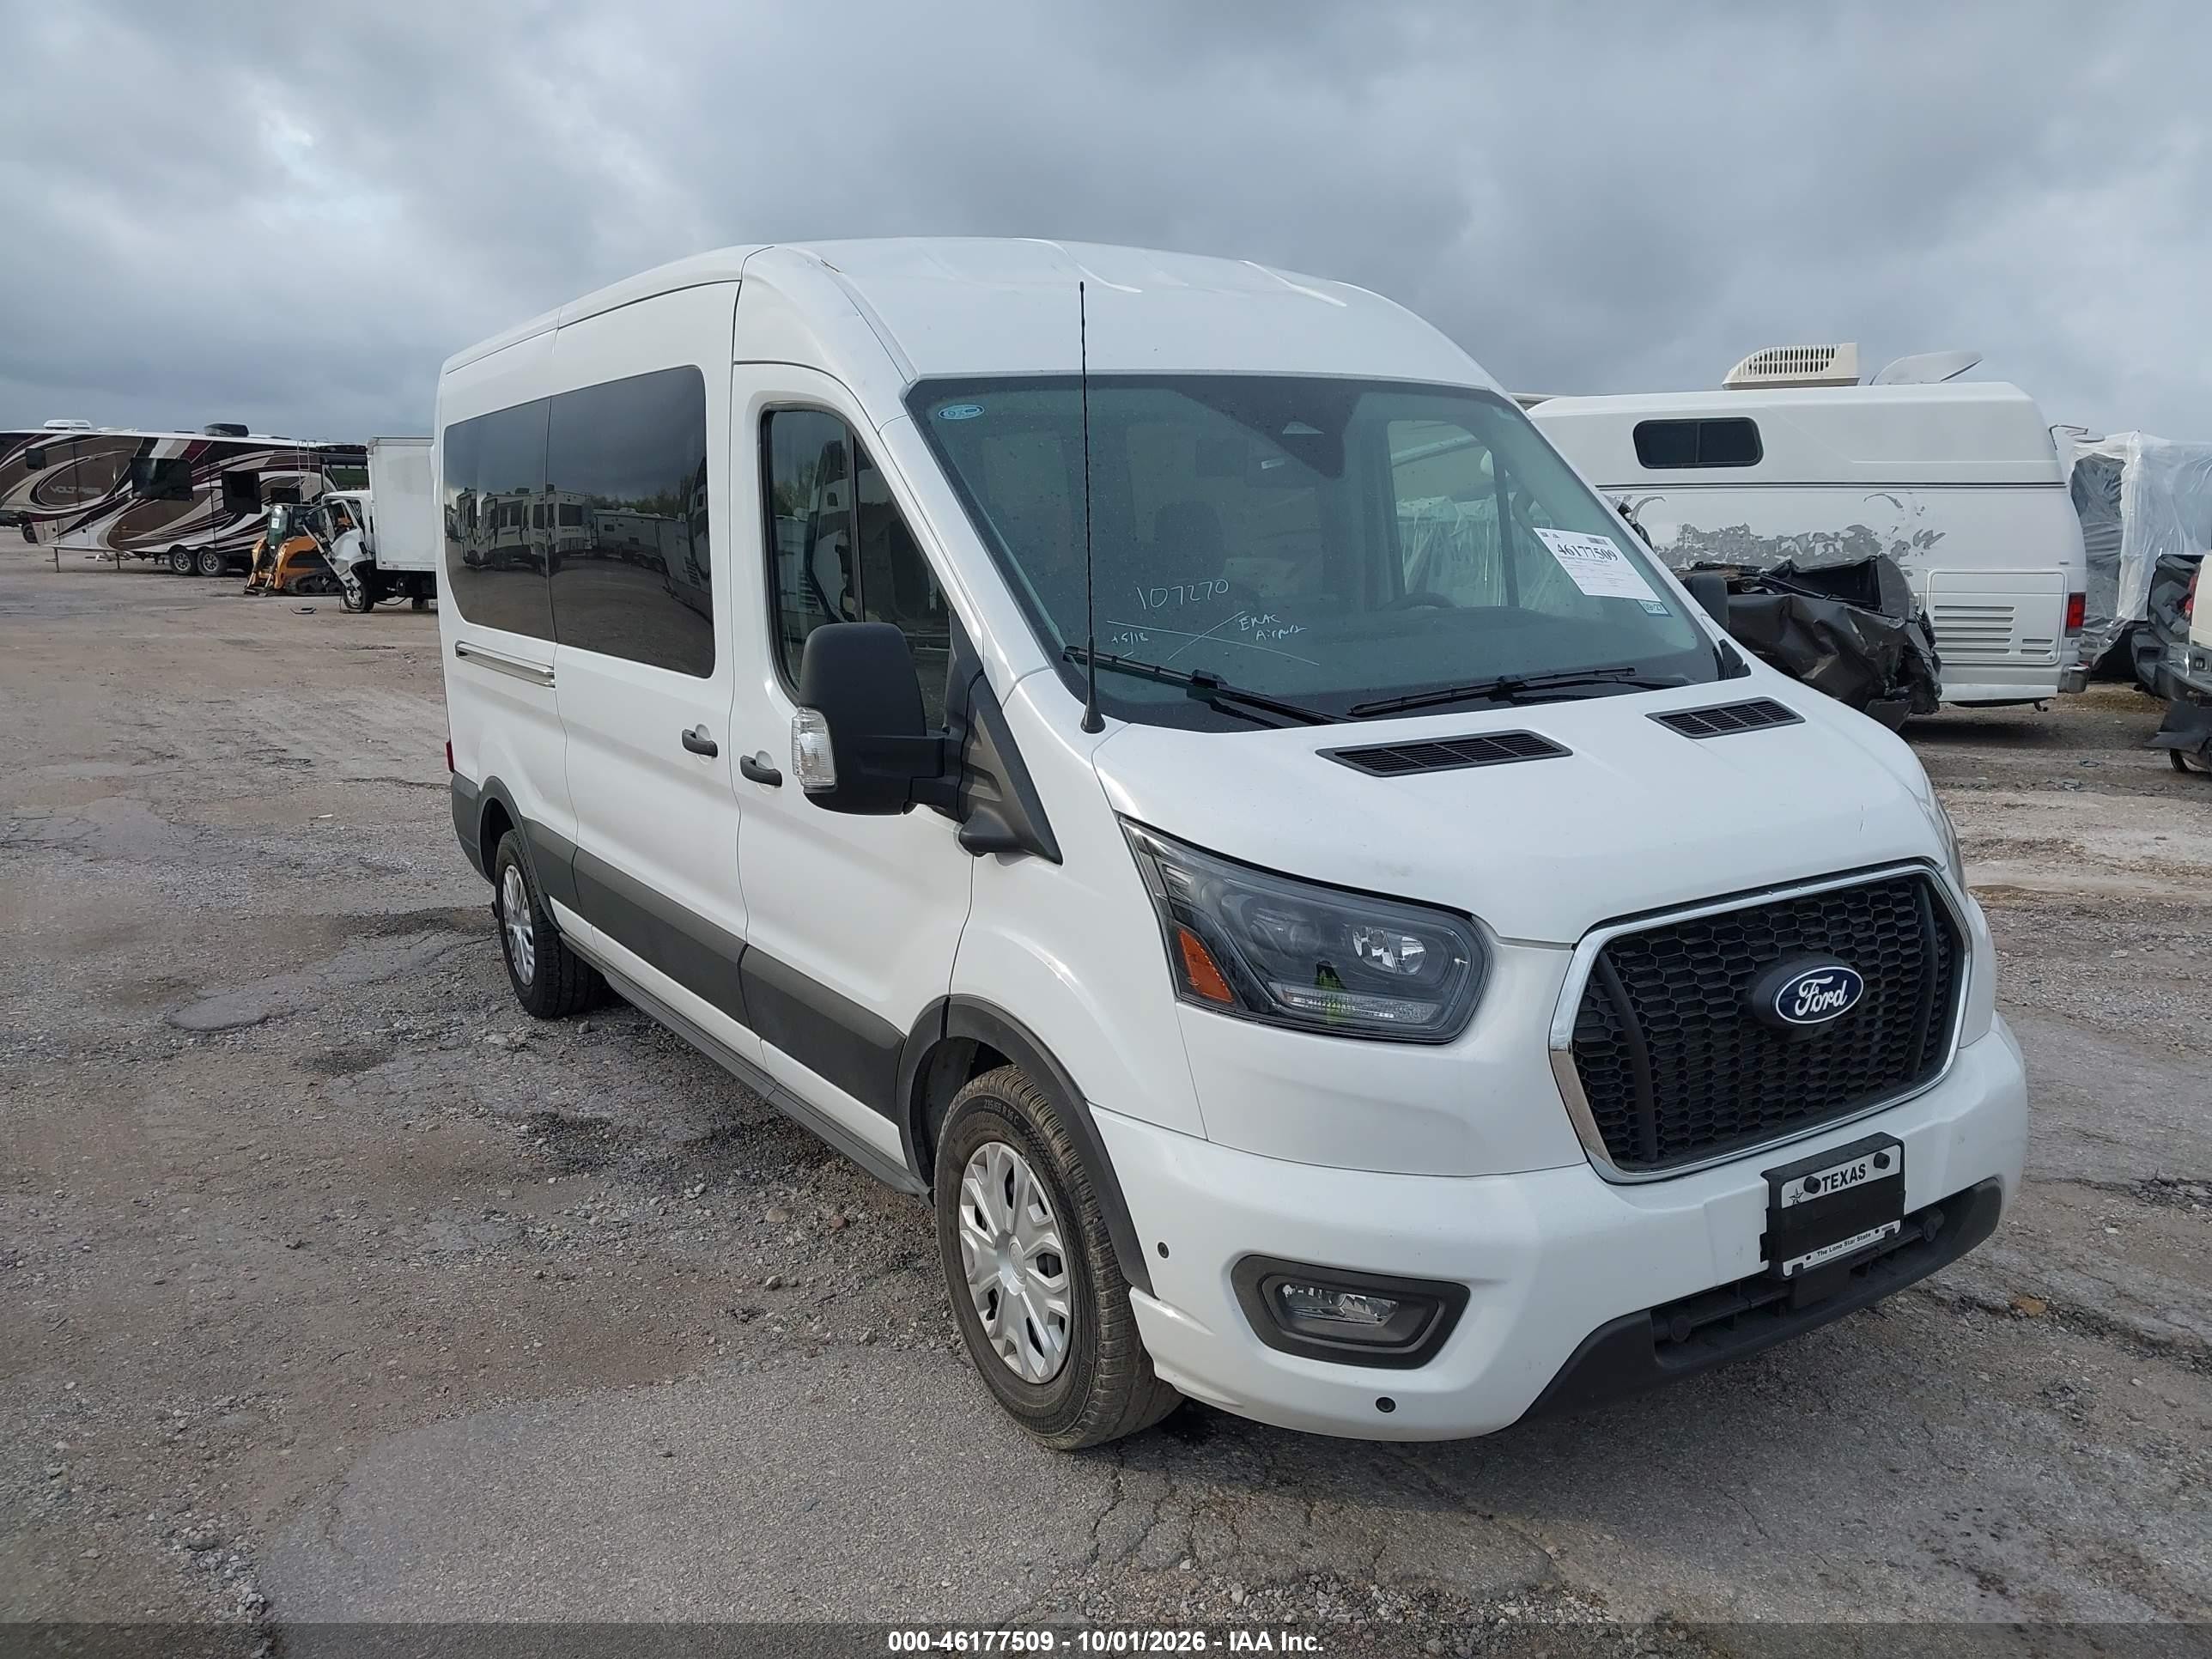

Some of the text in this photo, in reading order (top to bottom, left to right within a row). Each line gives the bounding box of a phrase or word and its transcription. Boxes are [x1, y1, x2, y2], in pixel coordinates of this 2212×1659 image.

[1557, 543, 1619, 562] 46177509
[1136, 579, 1229, 611] 107270
[1795, 975, 1848, 1017] Ford
[1821, 1163, 1866, 1193] TEXAS
[1816, 1232, 1871, 1257] The Lone Star State
